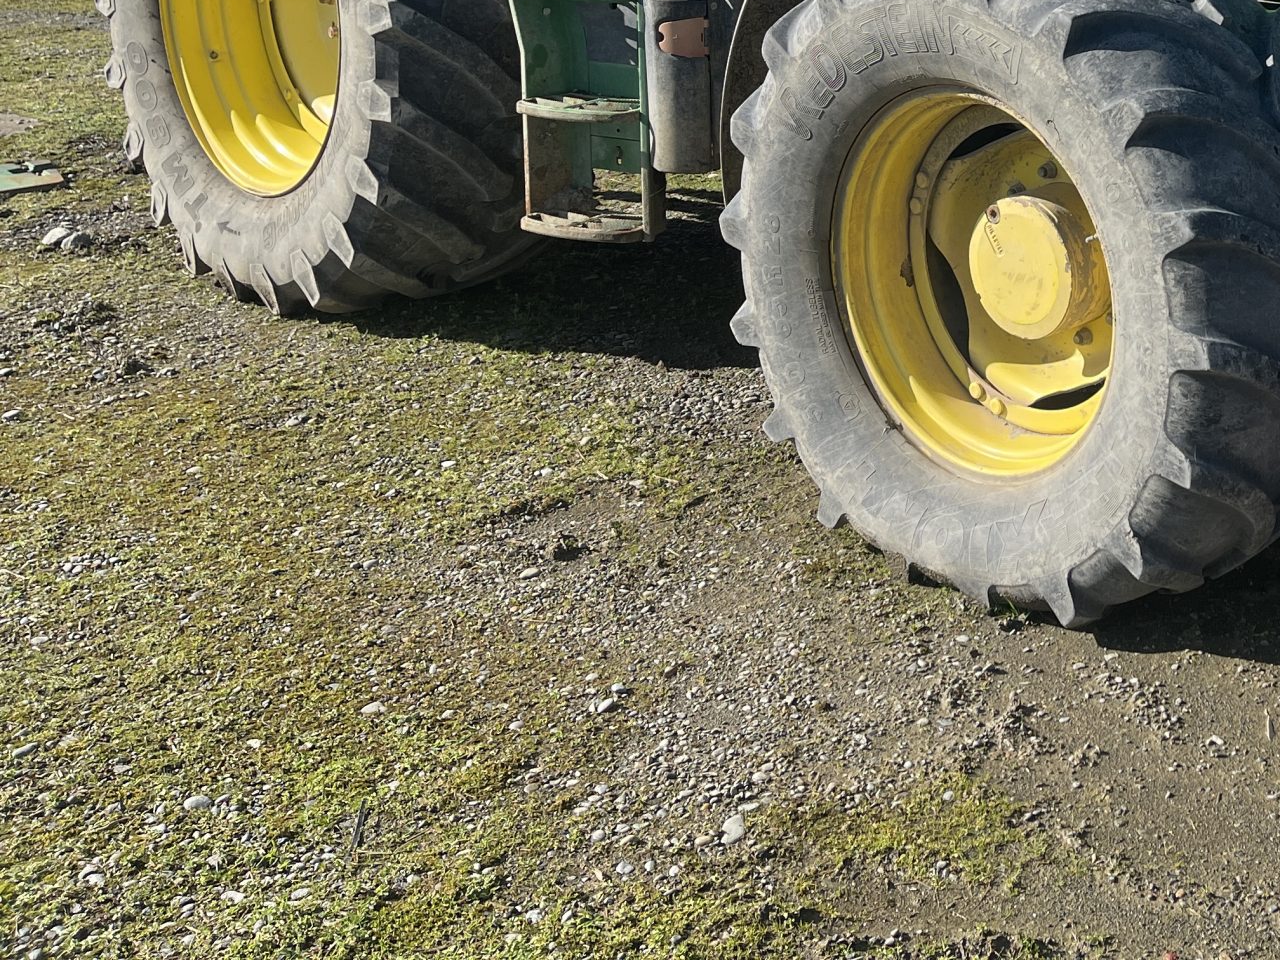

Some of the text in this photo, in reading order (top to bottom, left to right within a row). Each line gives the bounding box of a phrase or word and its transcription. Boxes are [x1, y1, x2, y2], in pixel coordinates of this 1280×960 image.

[779, 3, 955, 141] VREDESTEIN
[806, 278, 830, 355] RADIAL TUBELESS
